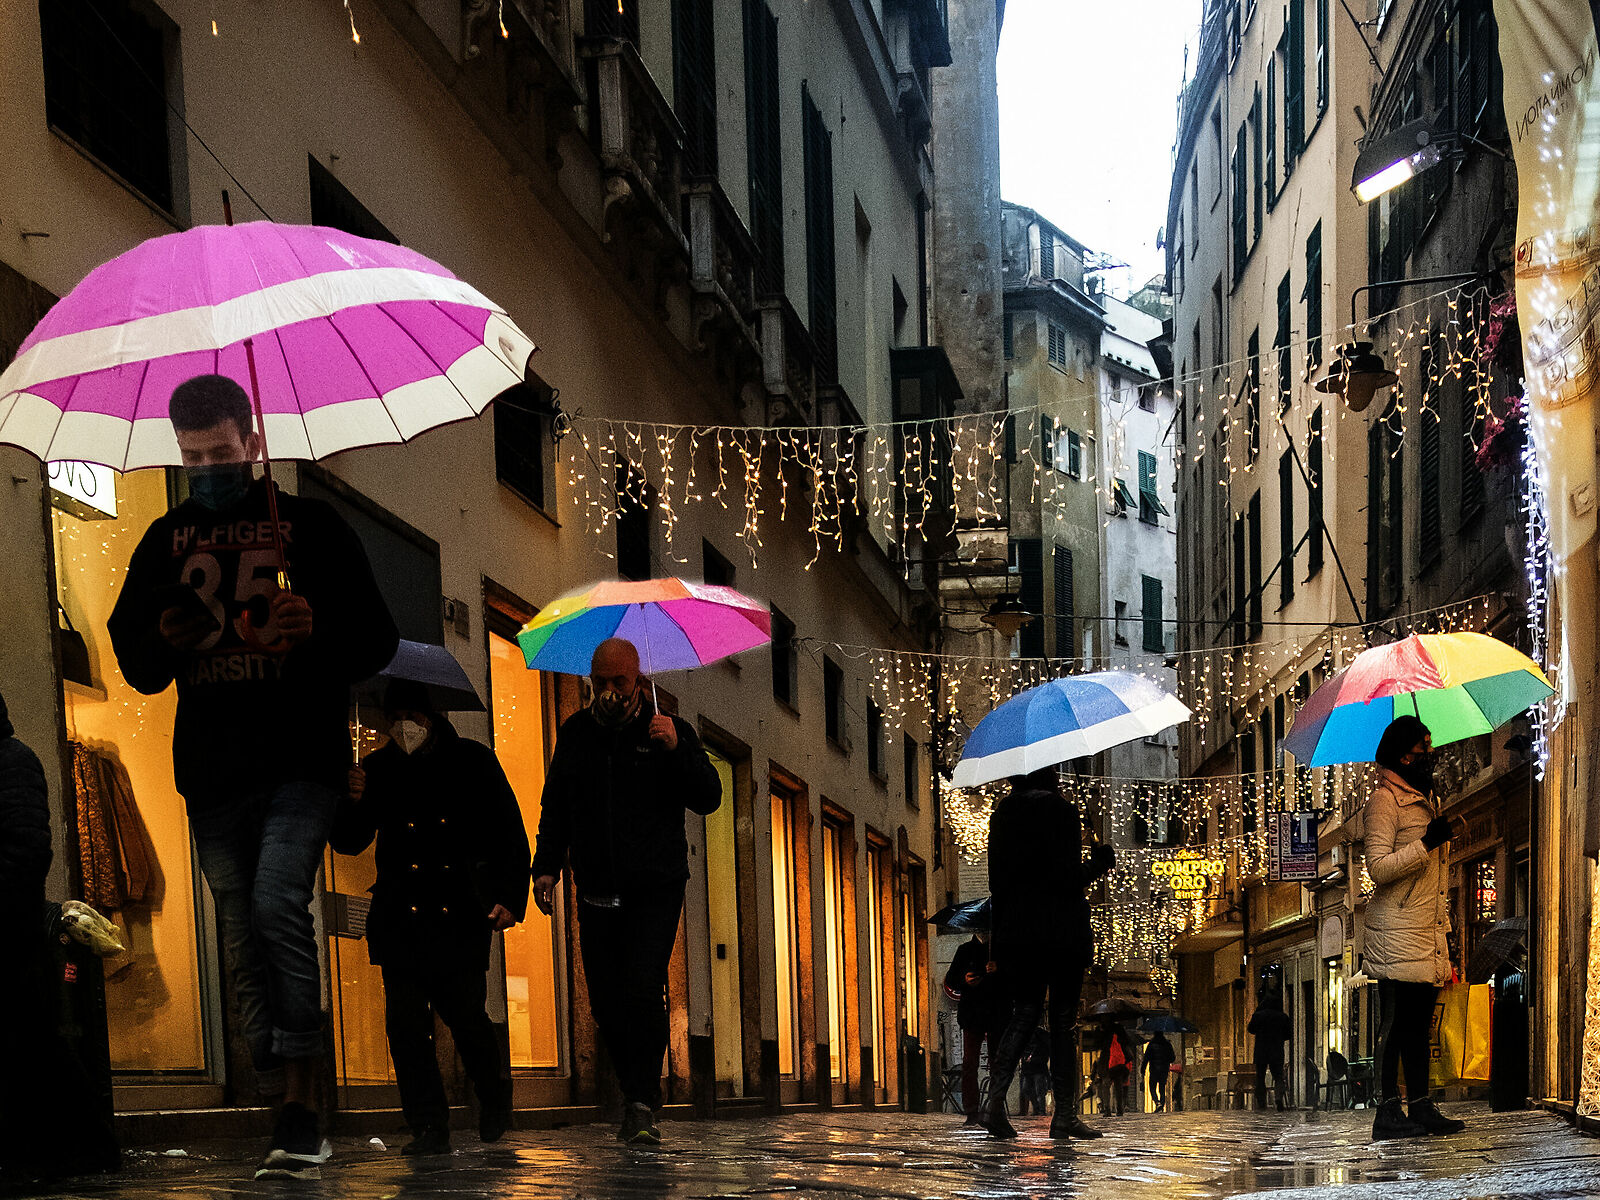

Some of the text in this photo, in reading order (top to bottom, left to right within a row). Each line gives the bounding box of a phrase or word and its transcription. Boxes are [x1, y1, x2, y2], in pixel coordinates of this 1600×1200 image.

[171, 520, 295, 551] HILFIGER
[1269, 825, 1277, 870] SELF
[1152, 860, 1224, 875] COMPRO
[1170, 875, 1206, 890] ORO
